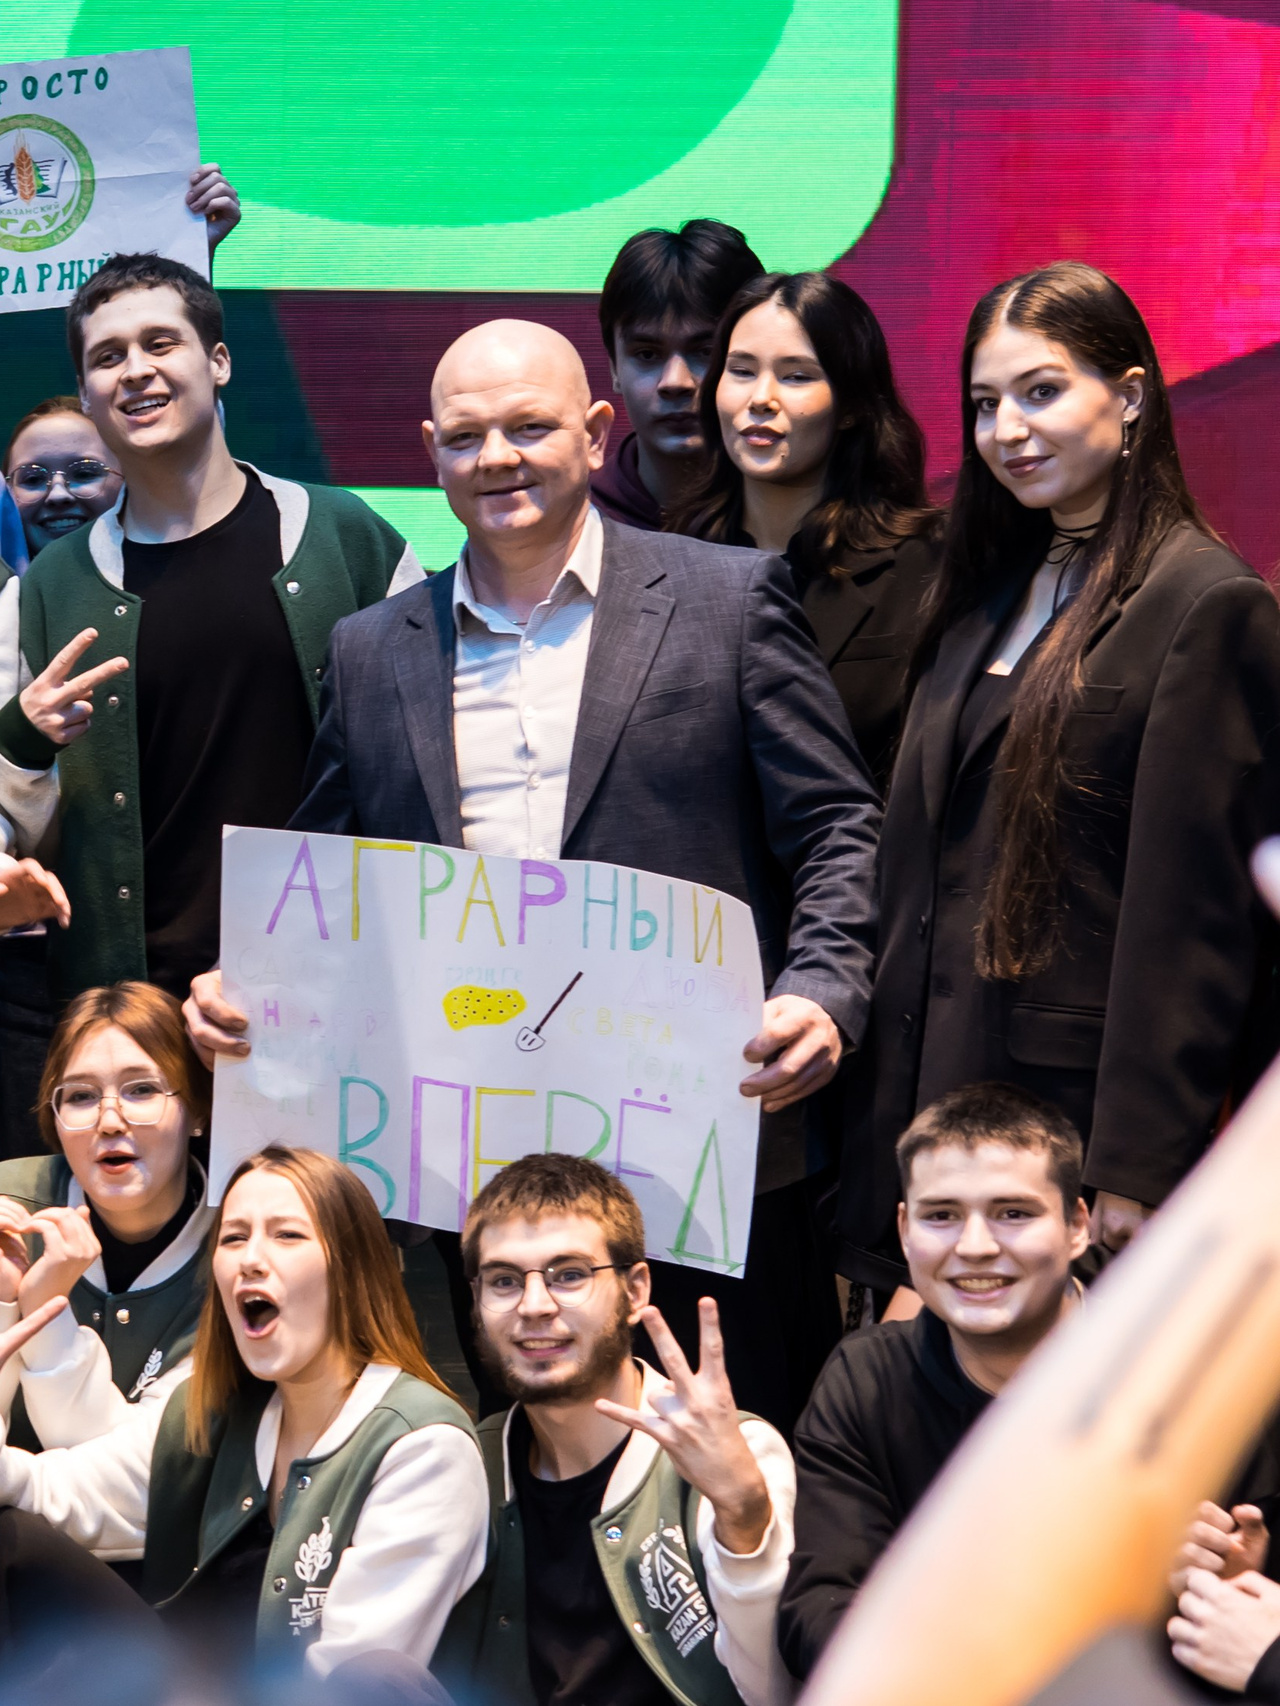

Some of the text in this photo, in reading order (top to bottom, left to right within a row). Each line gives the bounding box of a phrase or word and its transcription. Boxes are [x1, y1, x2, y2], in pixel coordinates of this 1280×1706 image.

[0, 202, 60, 216] КАЗАНСКИЙ
[0, 211, 61, 234] ГАУ
[266, 836, 723, 967] АГРАРНЫЙ
[567, 1006, 674, 1046] СВЕТА
[670, 1607, 699, 1643] KAZAN
